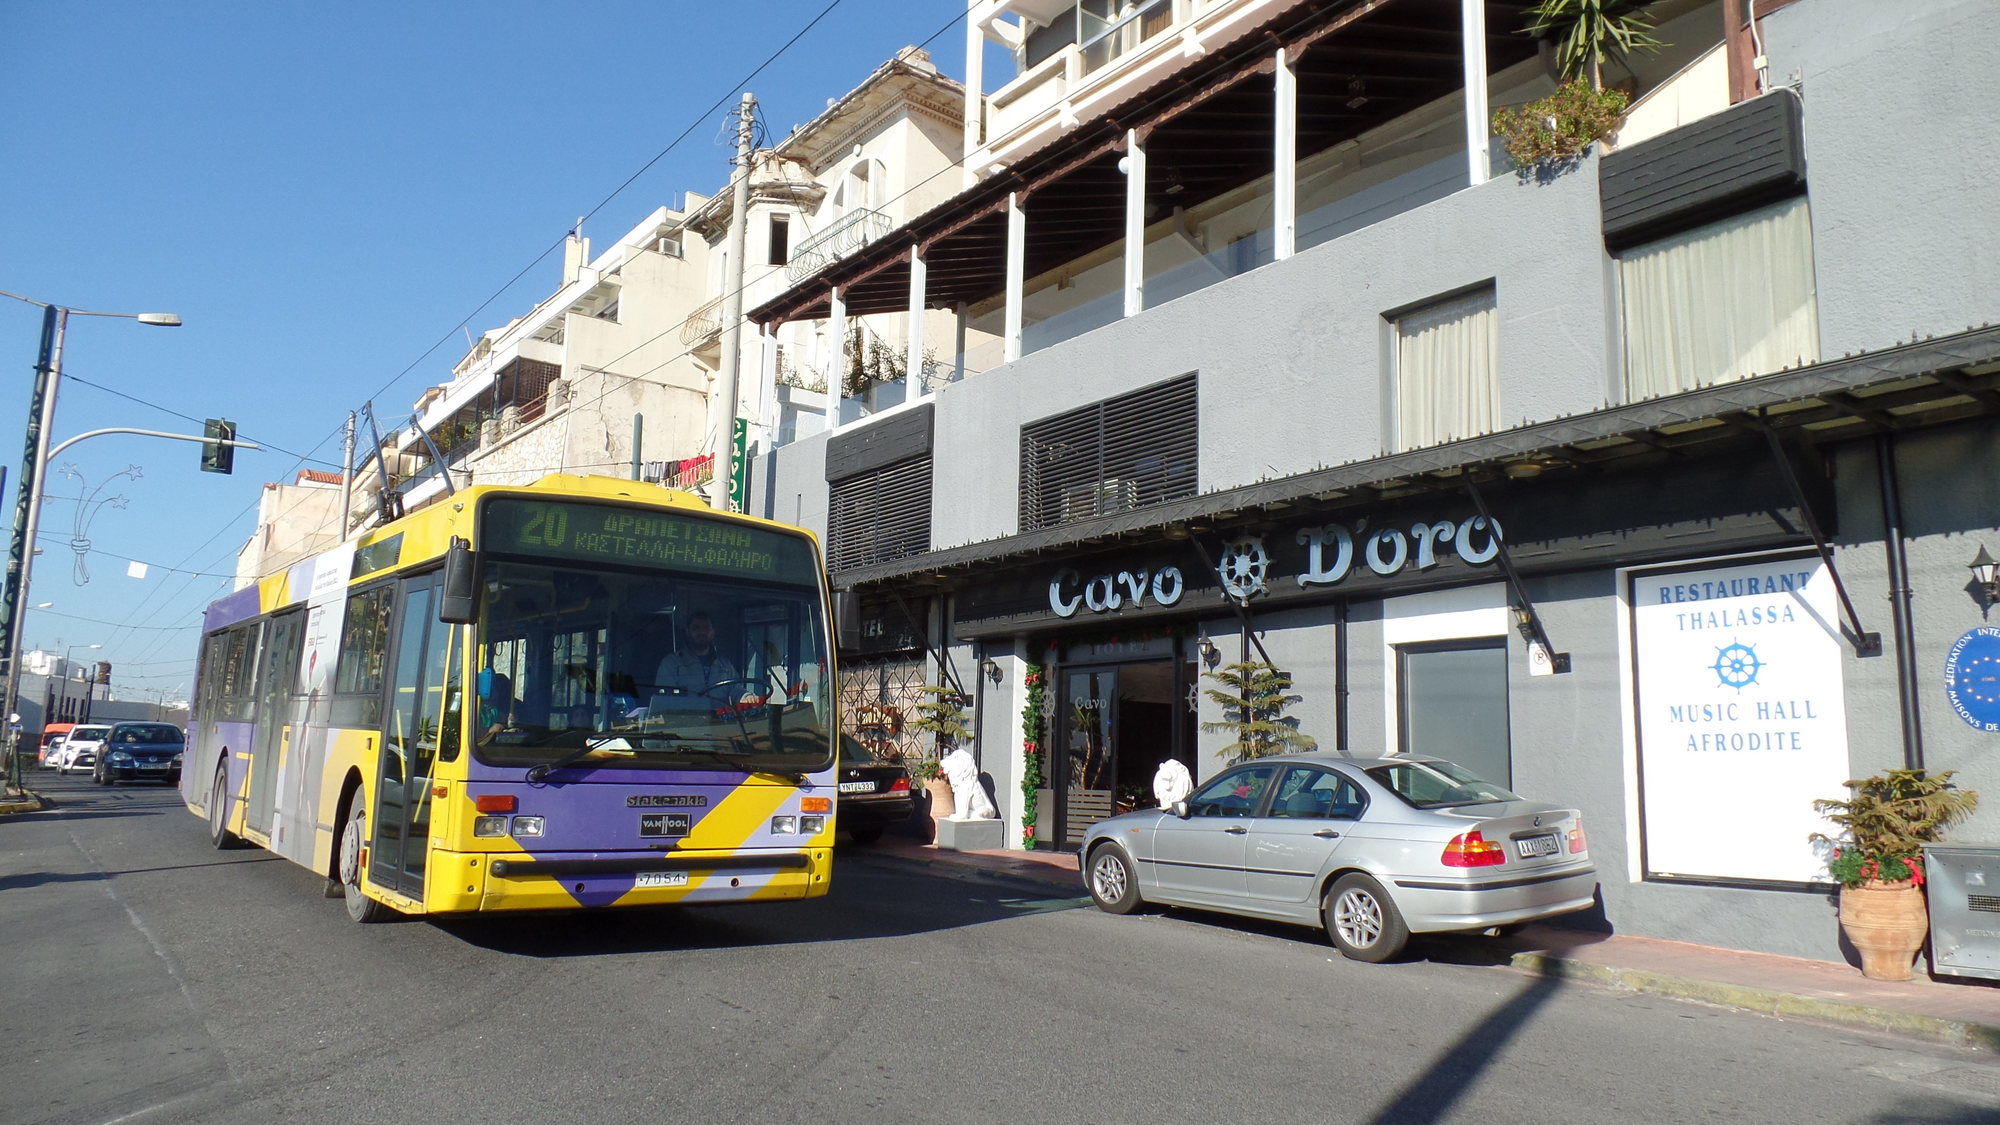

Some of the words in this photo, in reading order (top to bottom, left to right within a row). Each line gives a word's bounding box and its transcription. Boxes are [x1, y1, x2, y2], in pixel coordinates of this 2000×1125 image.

[520, 506, 568, 546] 20
[1048, 566, 1184, 618] Cavo
[1659, 571, 1811, 605] RESTAURANT
[1676, 604, 1796, 632] THALASSA
[1074, 696, 1107, 710] Cavo
[1669, 702, 1739, 723] MUSIC
[1757, 700, 1817, 720] HALL
[1948, 690, 1981, 728] MAISONS
[1985, 723, 1999, 732] DE
[1686, 731, 1802, 752] AFRODITE
[643, 872, 681, 886] 7054
